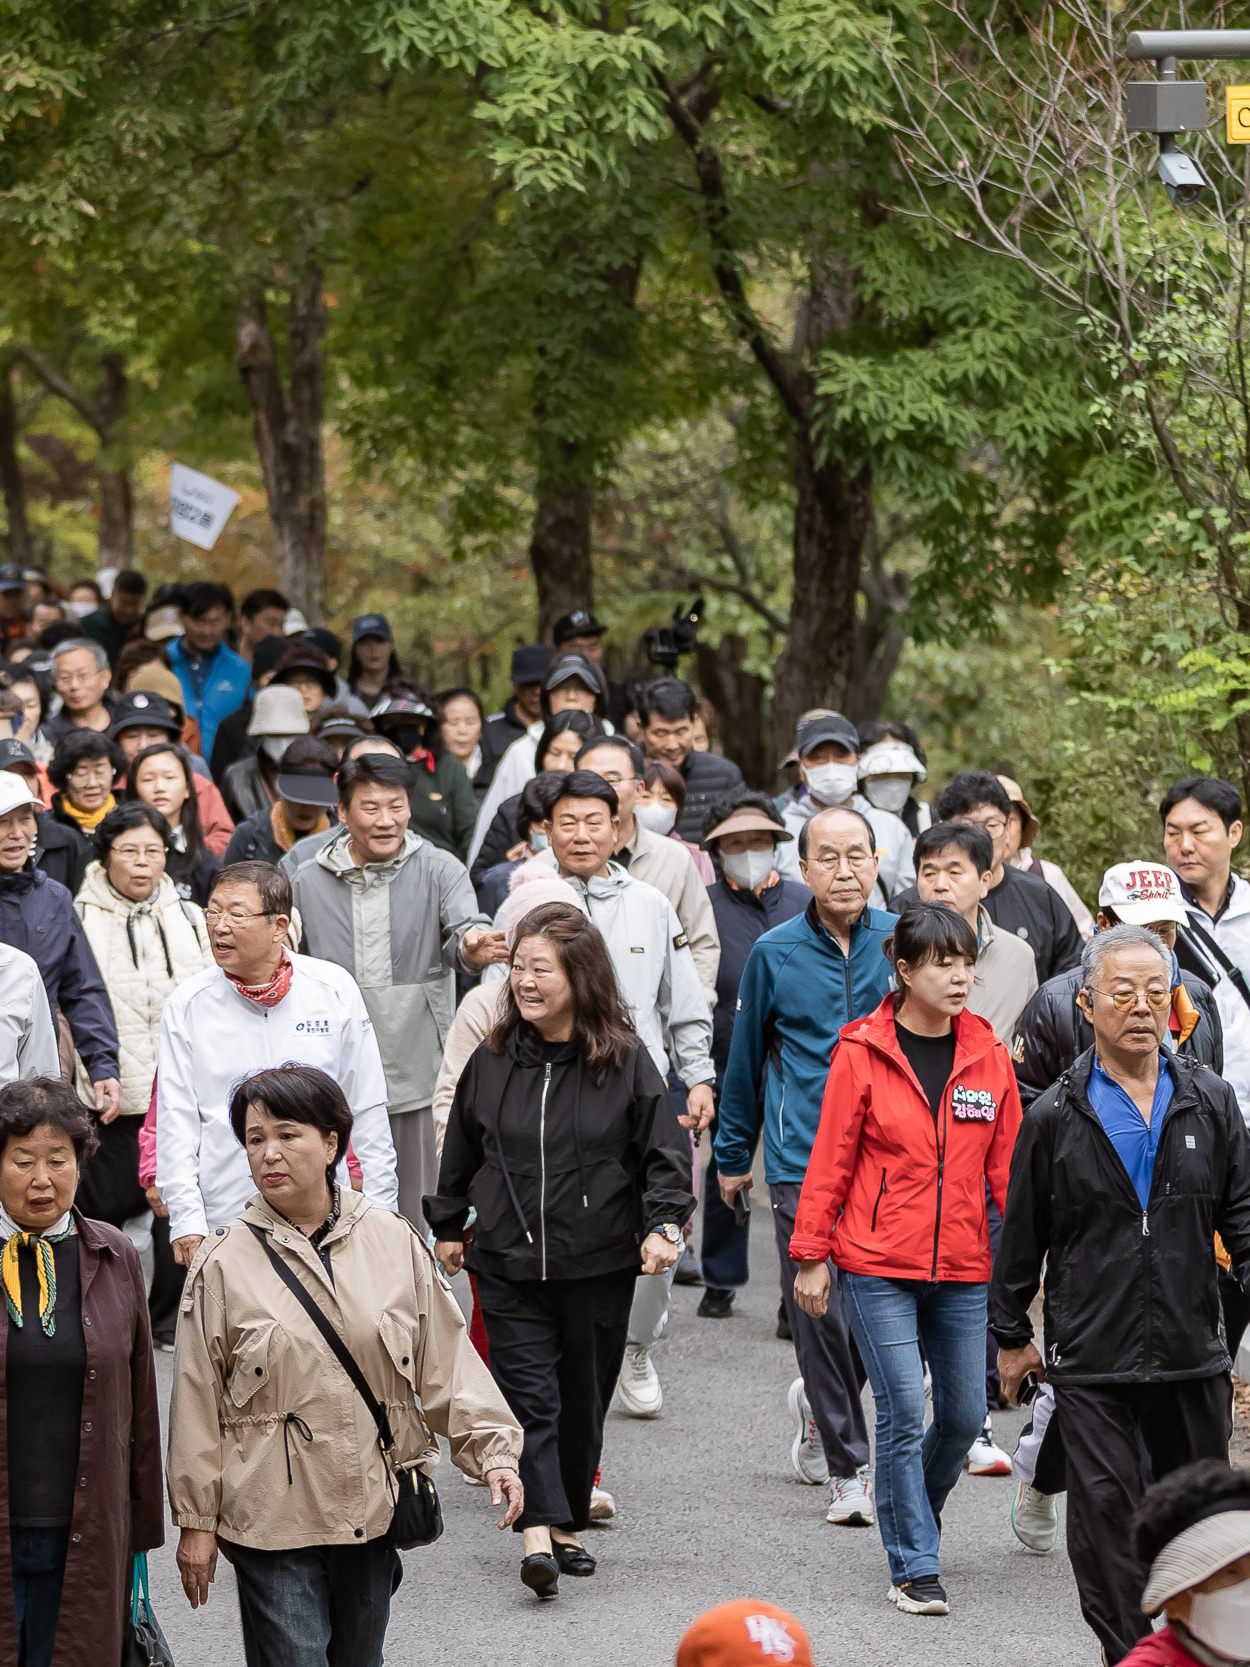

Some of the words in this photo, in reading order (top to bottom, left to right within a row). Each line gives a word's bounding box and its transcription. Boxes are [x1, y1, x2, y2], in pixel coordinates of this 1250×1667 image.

[1126, 870, 1172, 889] JEEP
[1140, 889, 1175, 901] Spirit
[953, 1088, 992, 1105] 시의원
[951, 1102, 995, 1121] 김혜영
